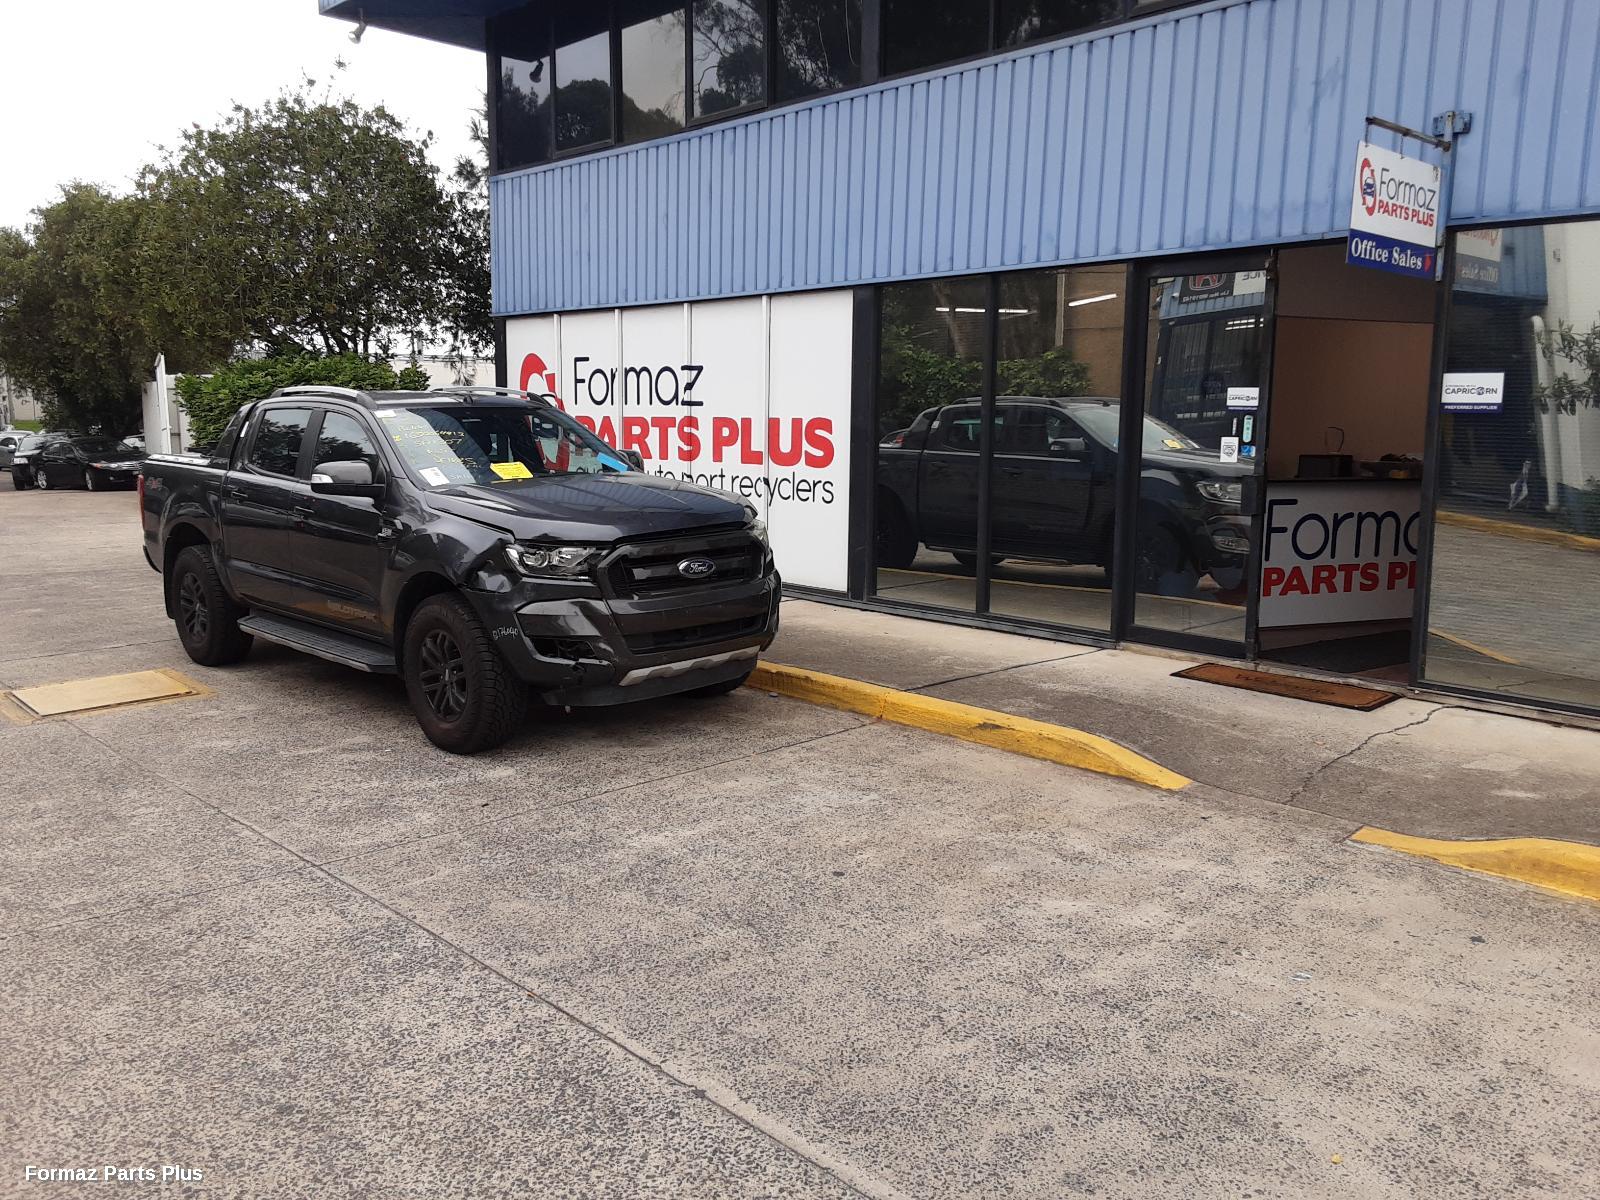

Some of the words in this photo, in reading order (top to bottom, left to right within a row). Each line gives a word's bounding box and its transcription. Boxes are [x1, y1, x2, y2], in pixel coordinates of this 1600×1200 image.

[1379, 167, 1437, 211] Formaz
[1378, 199, 1410, 221] PARTS
[1411, 208, 1435, 228] PLUS
[1351, 238, 1388, 262] Office
[1392, 247, 1422, 270] Sales
[573, 356, 704, 407] Formaz
[574, 415, 702, 462] PARTS
[712, 416, 835, 469] PLUS
[731, 471, 835, 506] recyclers
[688, 562, 710, 574] Ford
[1262, 563, 1380, 597] PARTS
